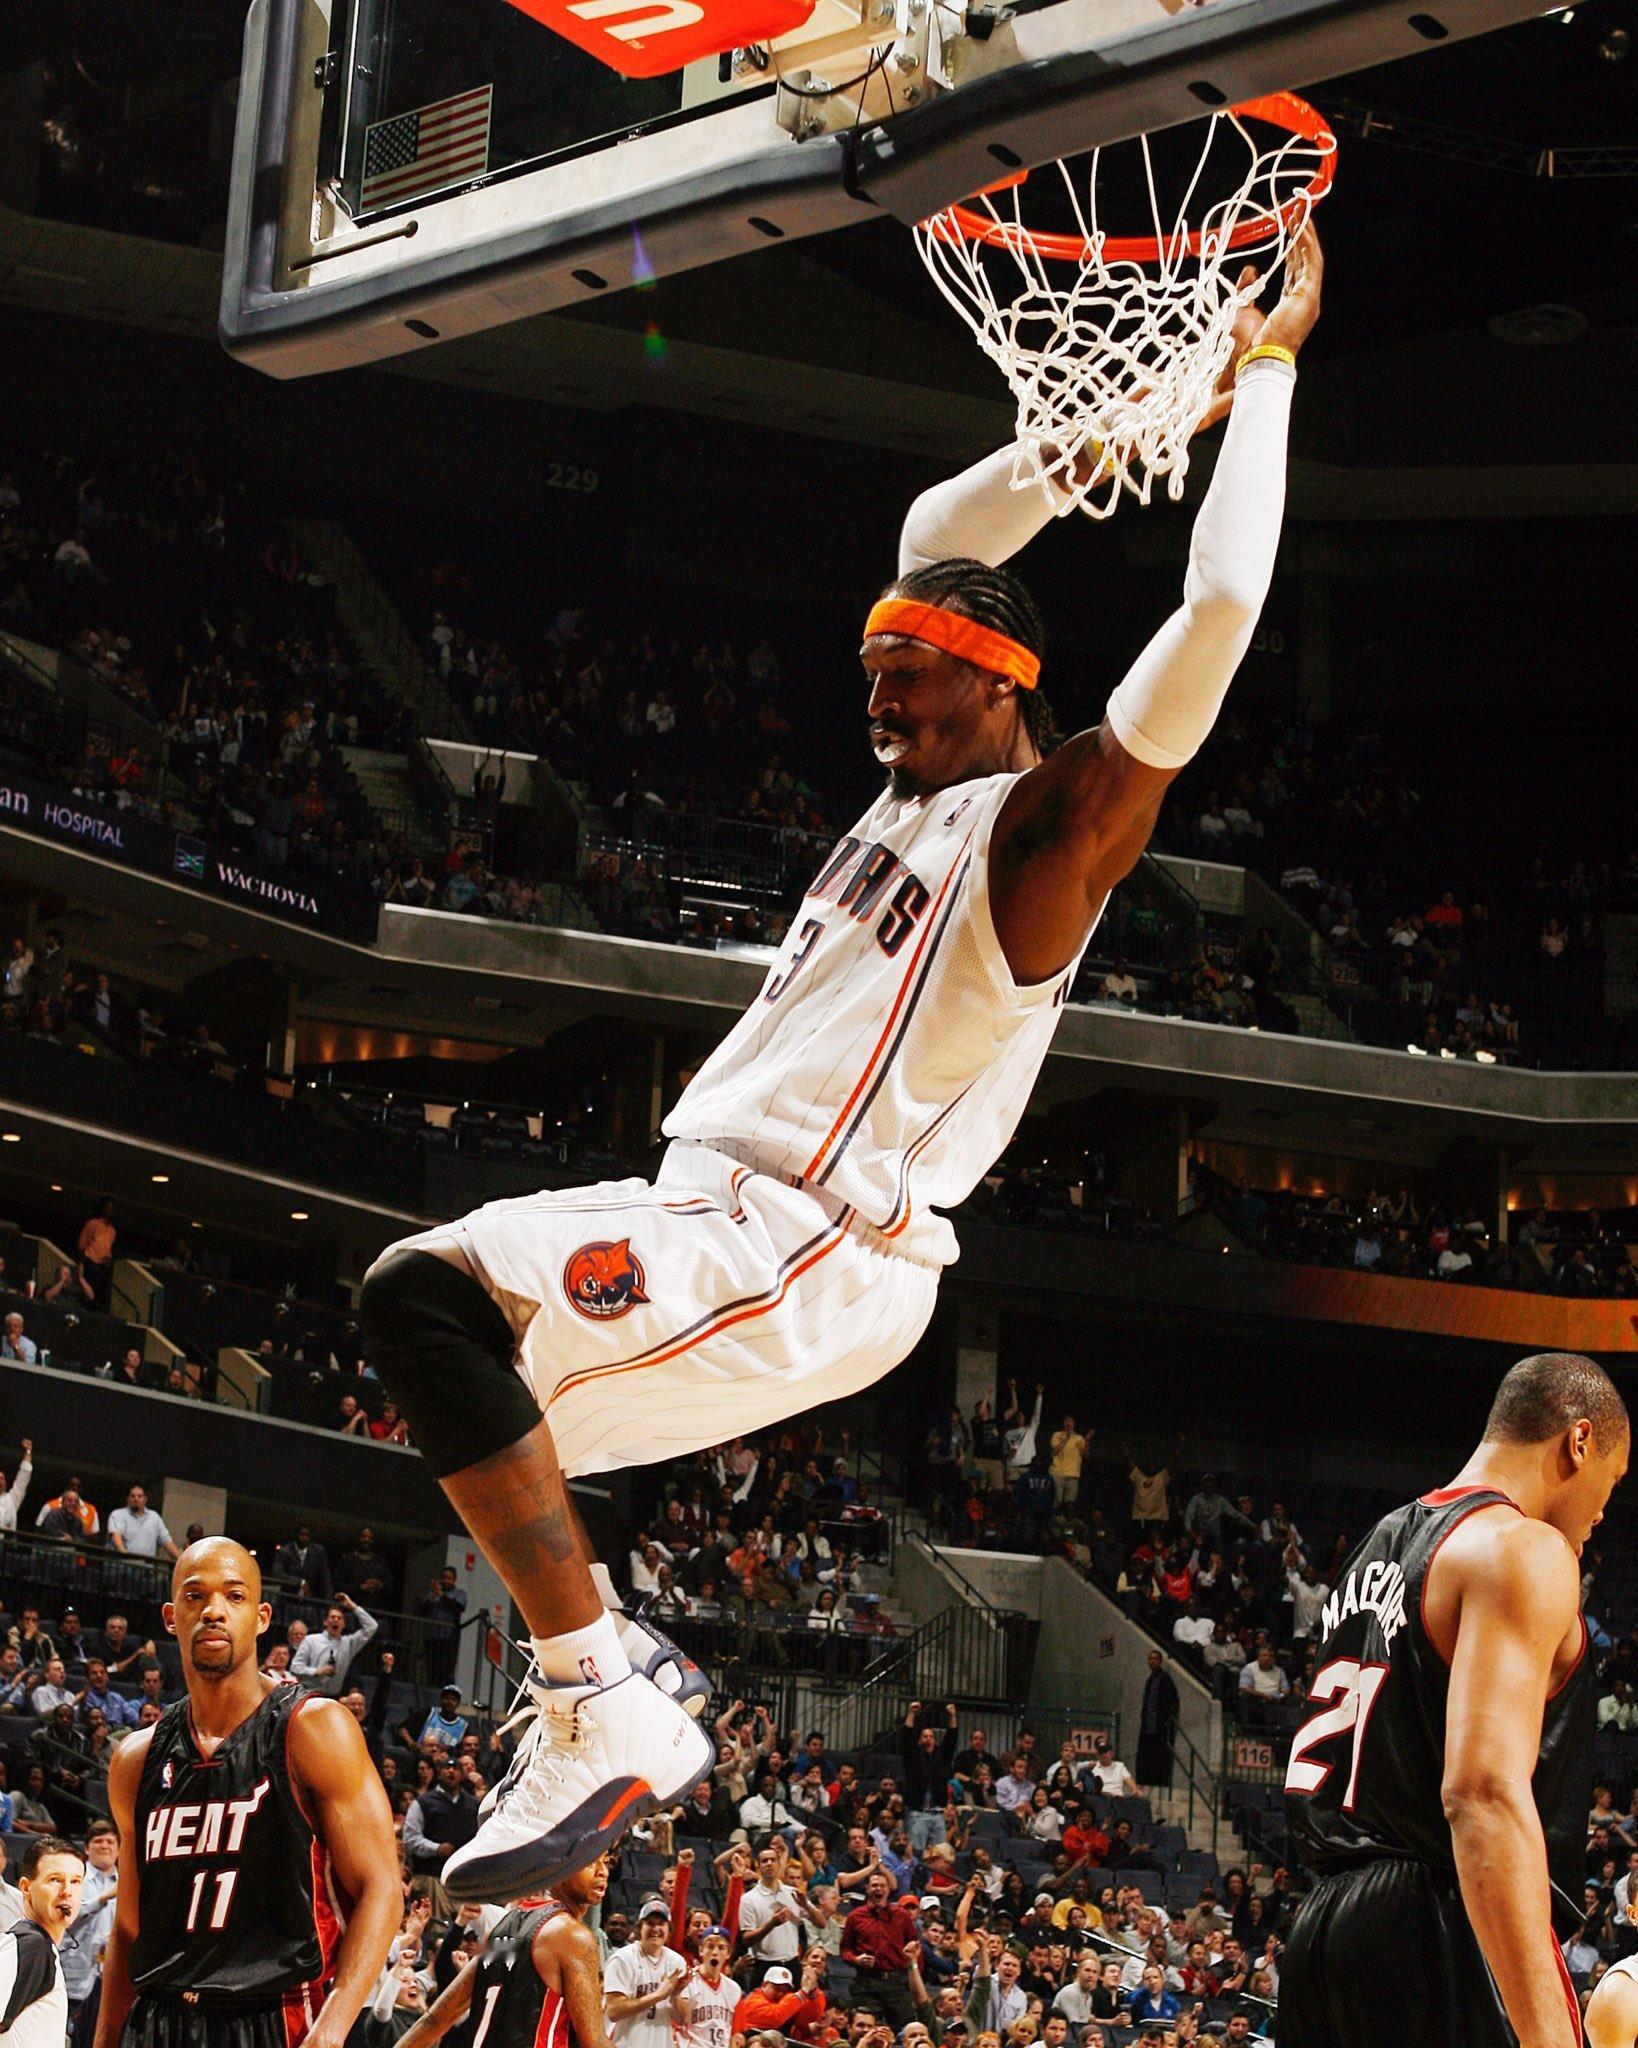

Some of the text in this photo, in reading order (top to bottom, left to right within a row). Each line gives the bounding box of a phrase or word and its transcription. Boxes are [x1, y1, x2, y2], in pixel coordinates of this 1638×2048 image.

[548, 463, 599, 492] 229
[1253, 629, 1285, 654] 30
[44, 803, 124, 848] HOSPITAL
[217, 862, 319, 914] WACHOVIA
[1074, 1734, 1105, 1751] 116
[1239, 1746, 1270, 1765] 116
[1284, 1656, 1391, 1812] 21
[144, 1776, 271, 1866] HEAT
[186, 1868, 240, 1933] 11
[472, 1984, 503, 2048] 1
